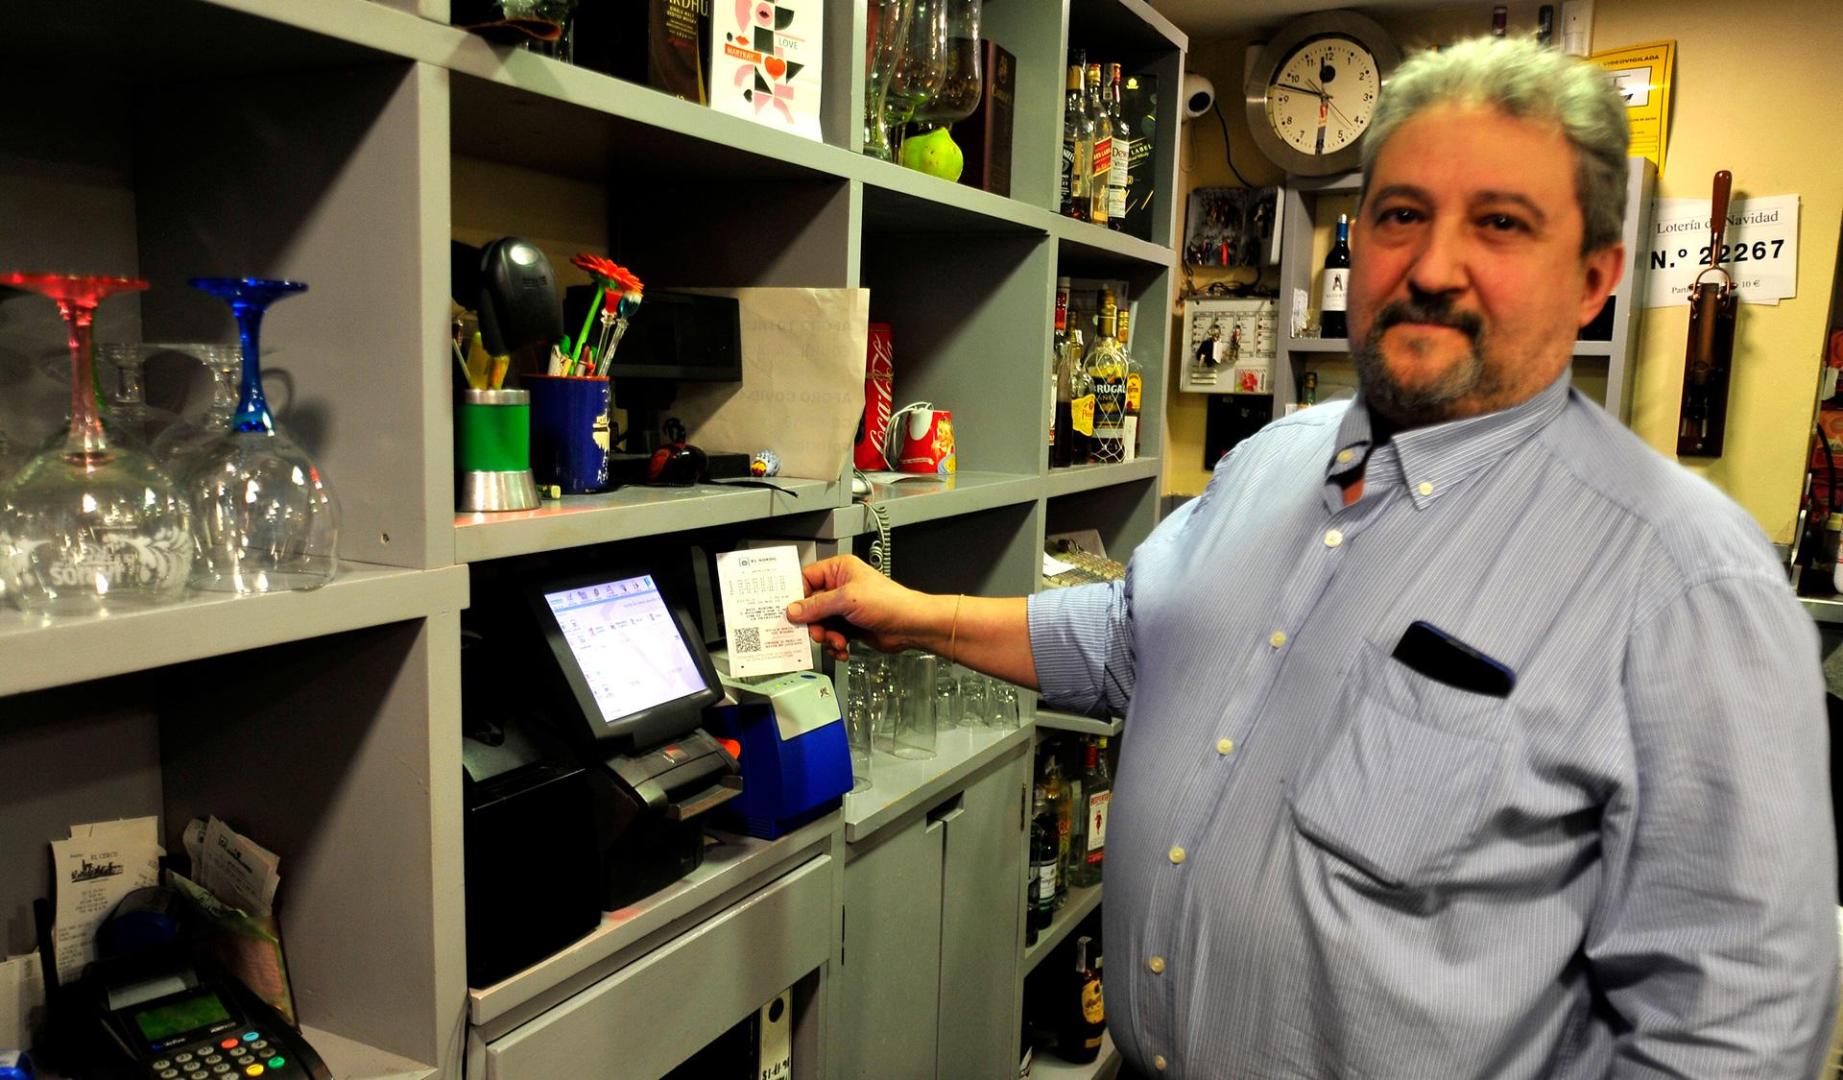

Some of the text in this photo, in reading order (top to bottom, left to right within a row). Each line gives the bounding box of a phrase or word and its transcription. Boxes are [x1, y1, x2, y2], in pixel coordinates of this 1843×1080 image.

[778, 38, 799, 49] LOVE
[1131, 143, 1152, 155] LABEL
[1657, 219, 1701, 234] Lotería
[1726, 210, 1779, 226] Navidad
[1699, 239, 1784, 265] 22267
[1742, 280, 1751, 288] 10
[1093, 384, 1126, 394] RUGAL
